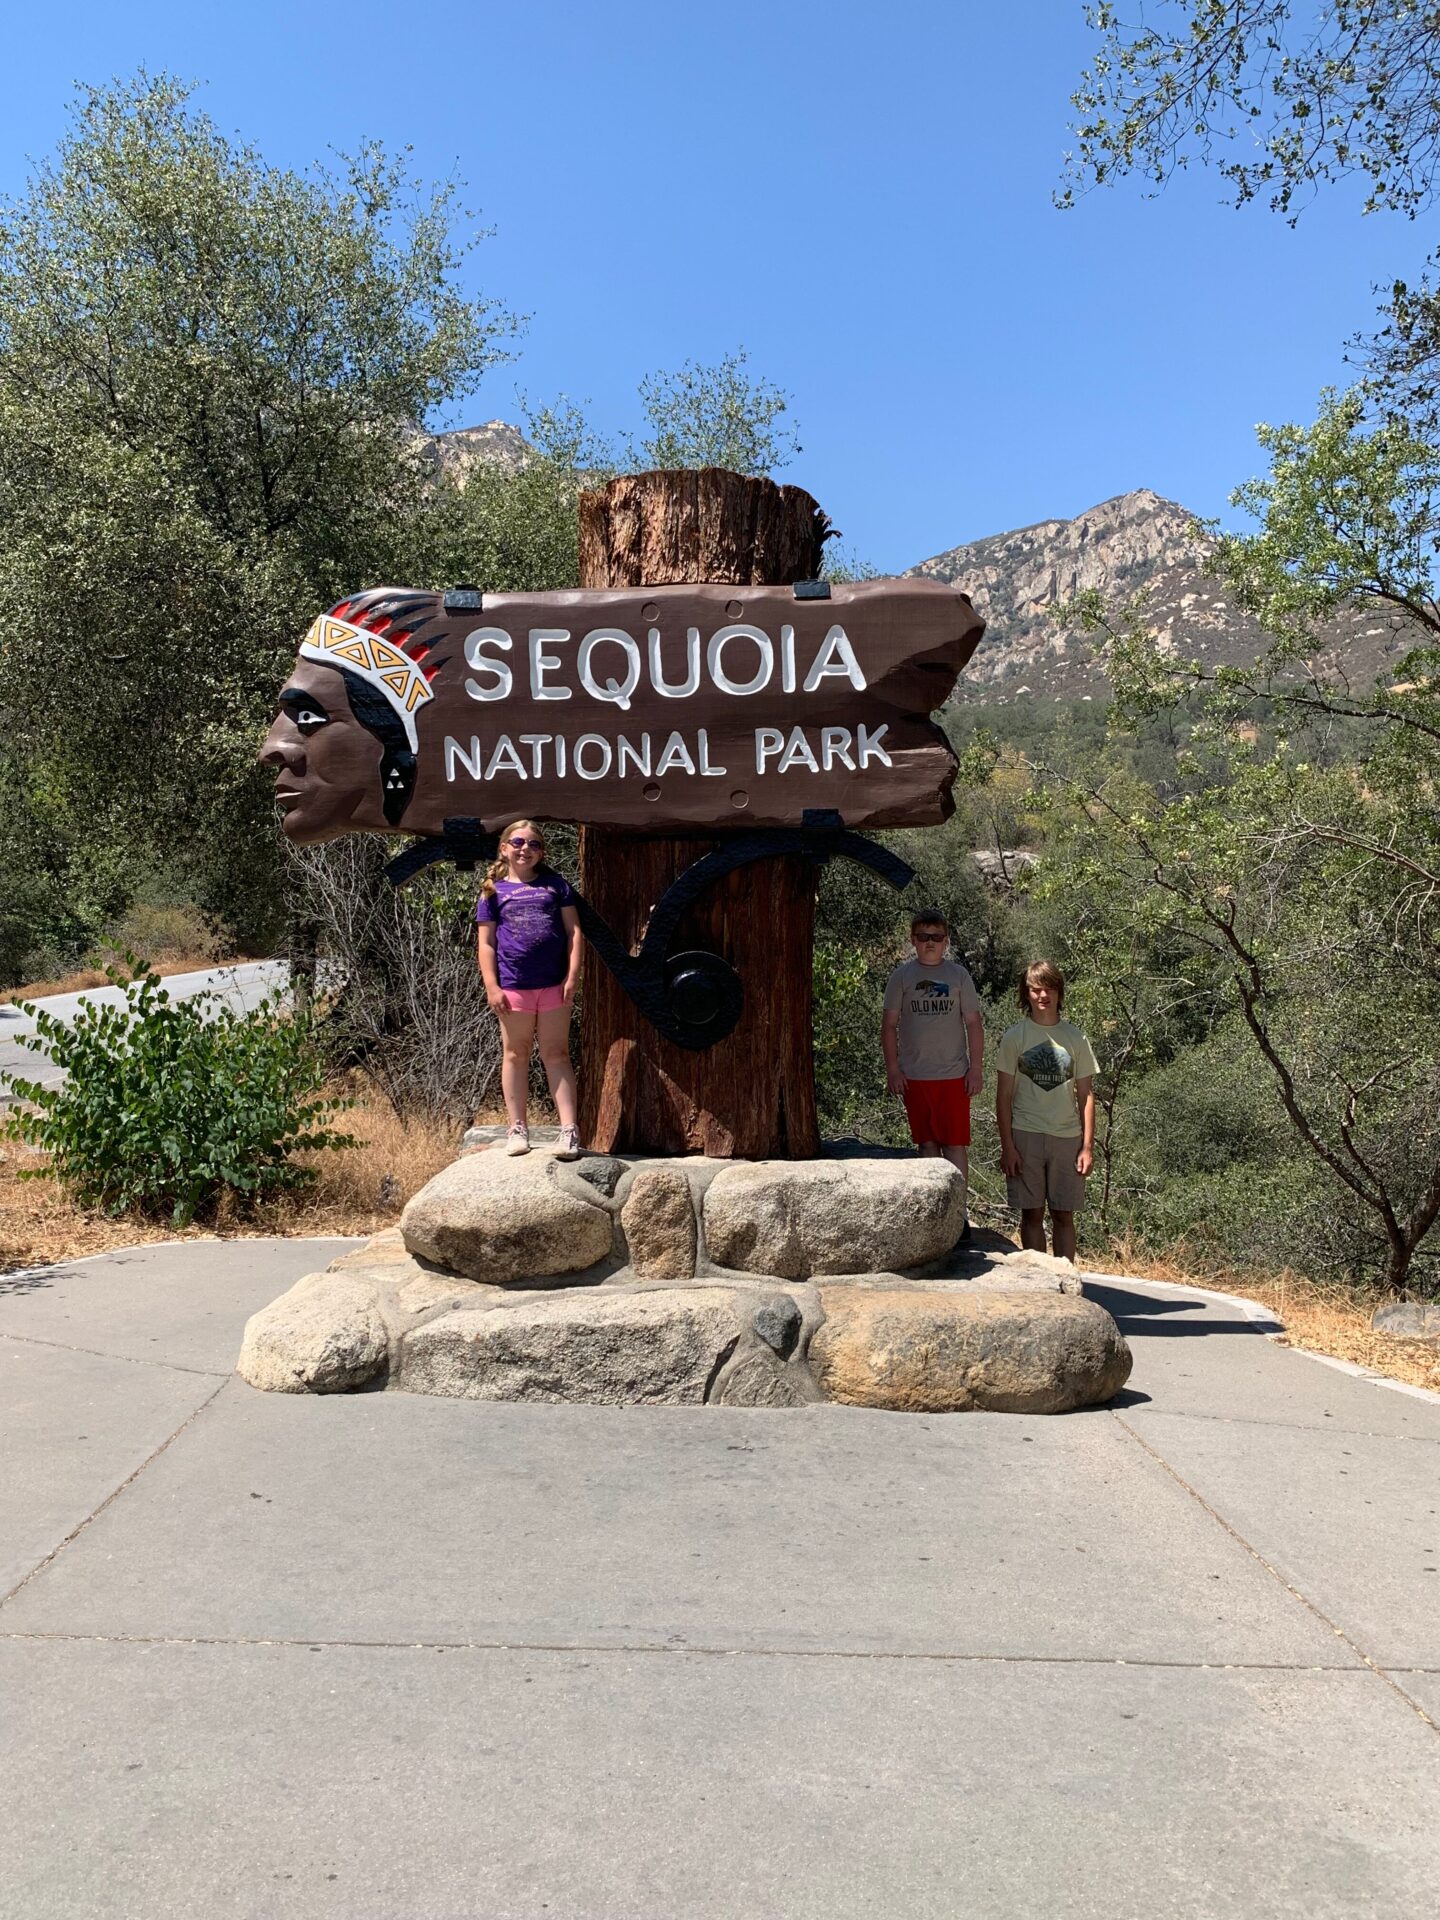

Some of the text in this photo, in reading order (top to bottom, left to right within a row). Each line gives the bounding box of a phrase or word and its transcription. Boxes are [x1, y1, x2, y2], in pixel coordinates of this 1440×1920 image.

[464, 624, 868, 711] SEQUOIA
[444, 723, 893, 782] NATIONAL PARK
[911, 1000, 955, 1012] OLD NAVY
